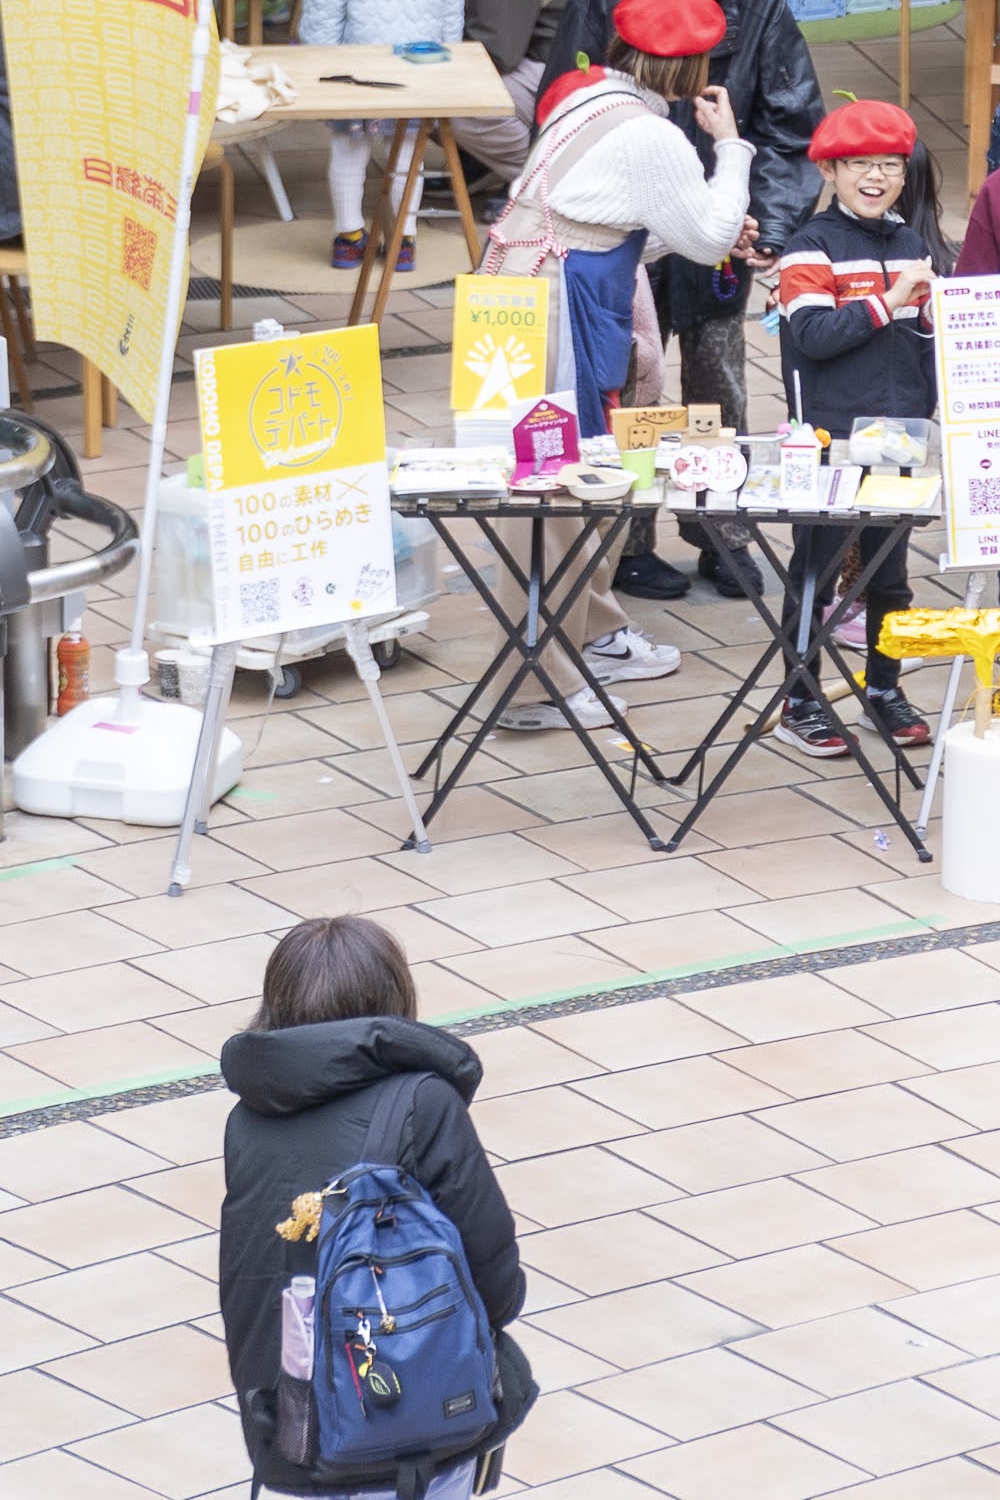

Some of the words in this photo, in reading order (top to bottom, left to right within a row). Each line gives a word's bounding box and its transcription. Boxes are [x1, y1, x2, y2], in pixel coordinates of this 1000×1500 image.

[470, 310, 536, 326] ¥1,000
[201, 352, 221, 437] KODOMO
[267, 381, 322, 415] コドモ
[265, 412, 332, 447] デパート
[978, 429, 1000, 439] LINE
[236, 503, 373, 544] 100のひらめき
[978, 535, 999, 544] LINE
[239, 540, 328, 573] 自由に工作
[980, 546, 998, 556] 登録
